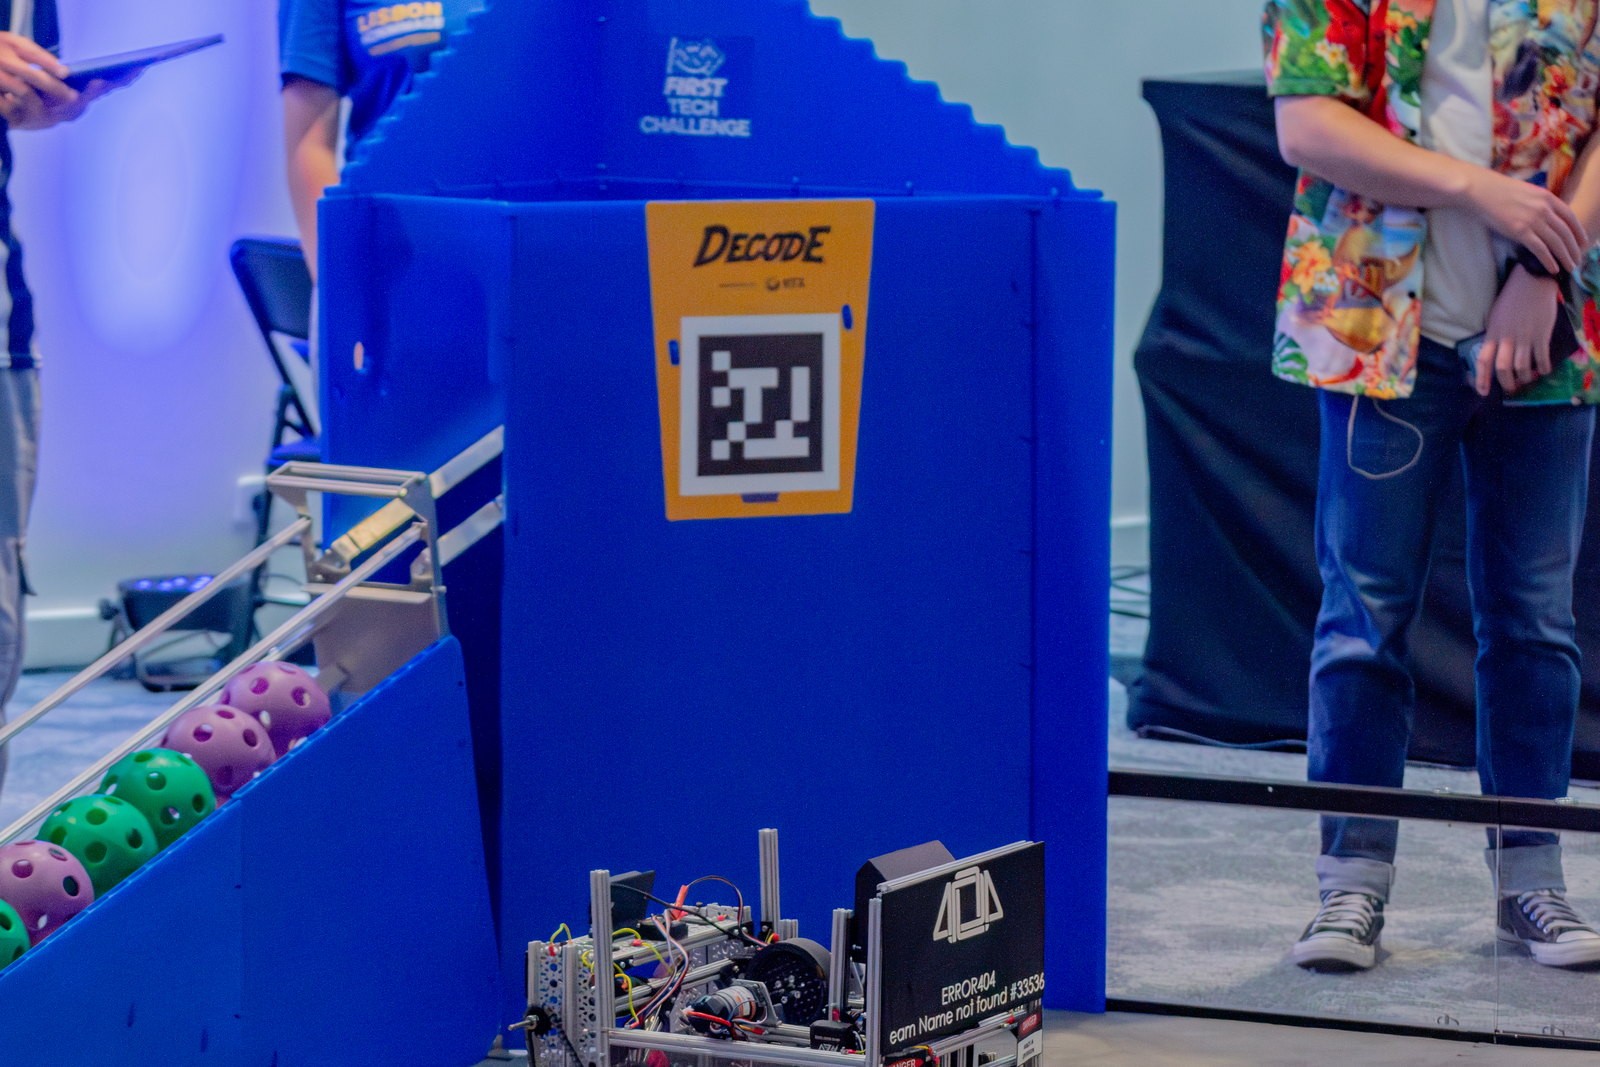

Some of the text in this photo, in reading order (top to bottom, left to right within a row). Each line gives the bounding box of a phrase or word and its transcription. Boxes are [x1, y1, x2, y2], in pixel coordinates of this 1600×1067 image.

[357, 2, 442, 33] LISBON
[664, 76, 728, 97] FIRST
[667, 98, 718, 116] TECH
[639, 115, 751, 136] CHALLENGE
[941, 970, 996, 1006] ERROR404
[889, 972, 1045, 1045] eam Name not found #33536
